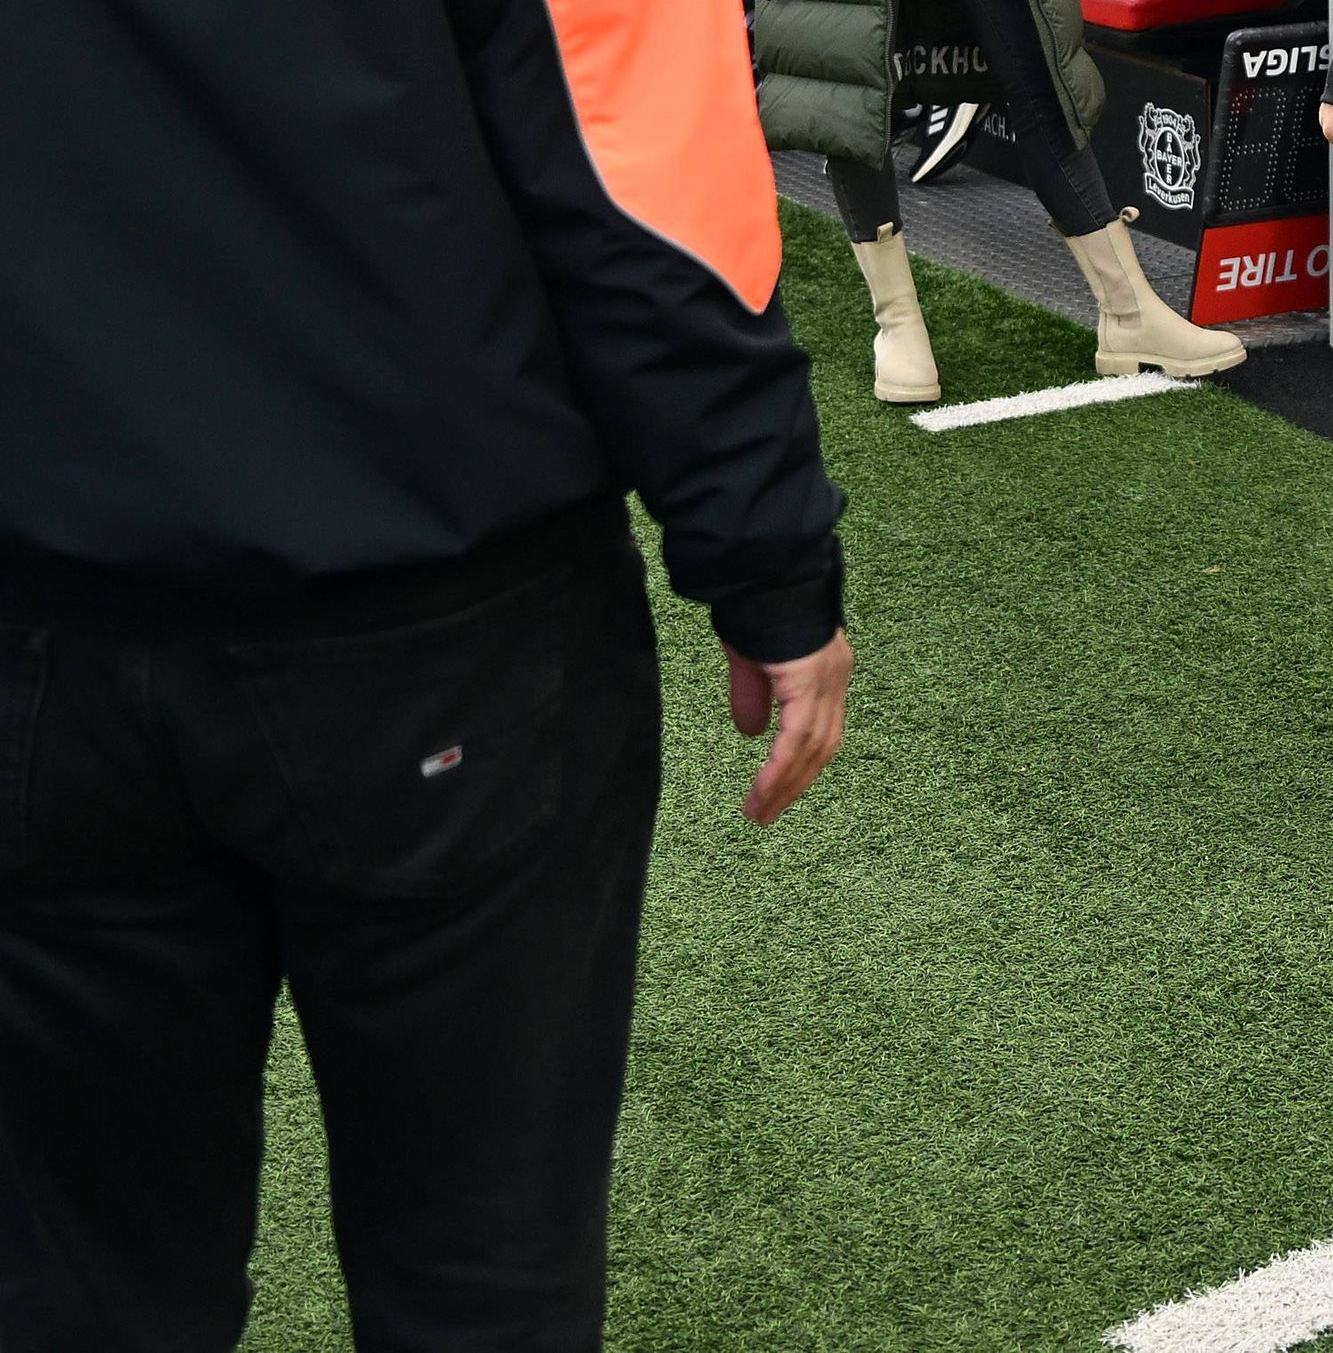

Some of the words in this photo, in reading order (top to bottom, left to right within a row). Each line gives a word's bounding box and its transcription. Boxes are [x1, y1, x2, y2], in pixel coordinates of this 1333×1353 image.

[1157, 149, 1182, 166] BAYER
[1148, 177, 1190, 204] Leverkusen
[1216, 248, 1298, 292] TIRE
